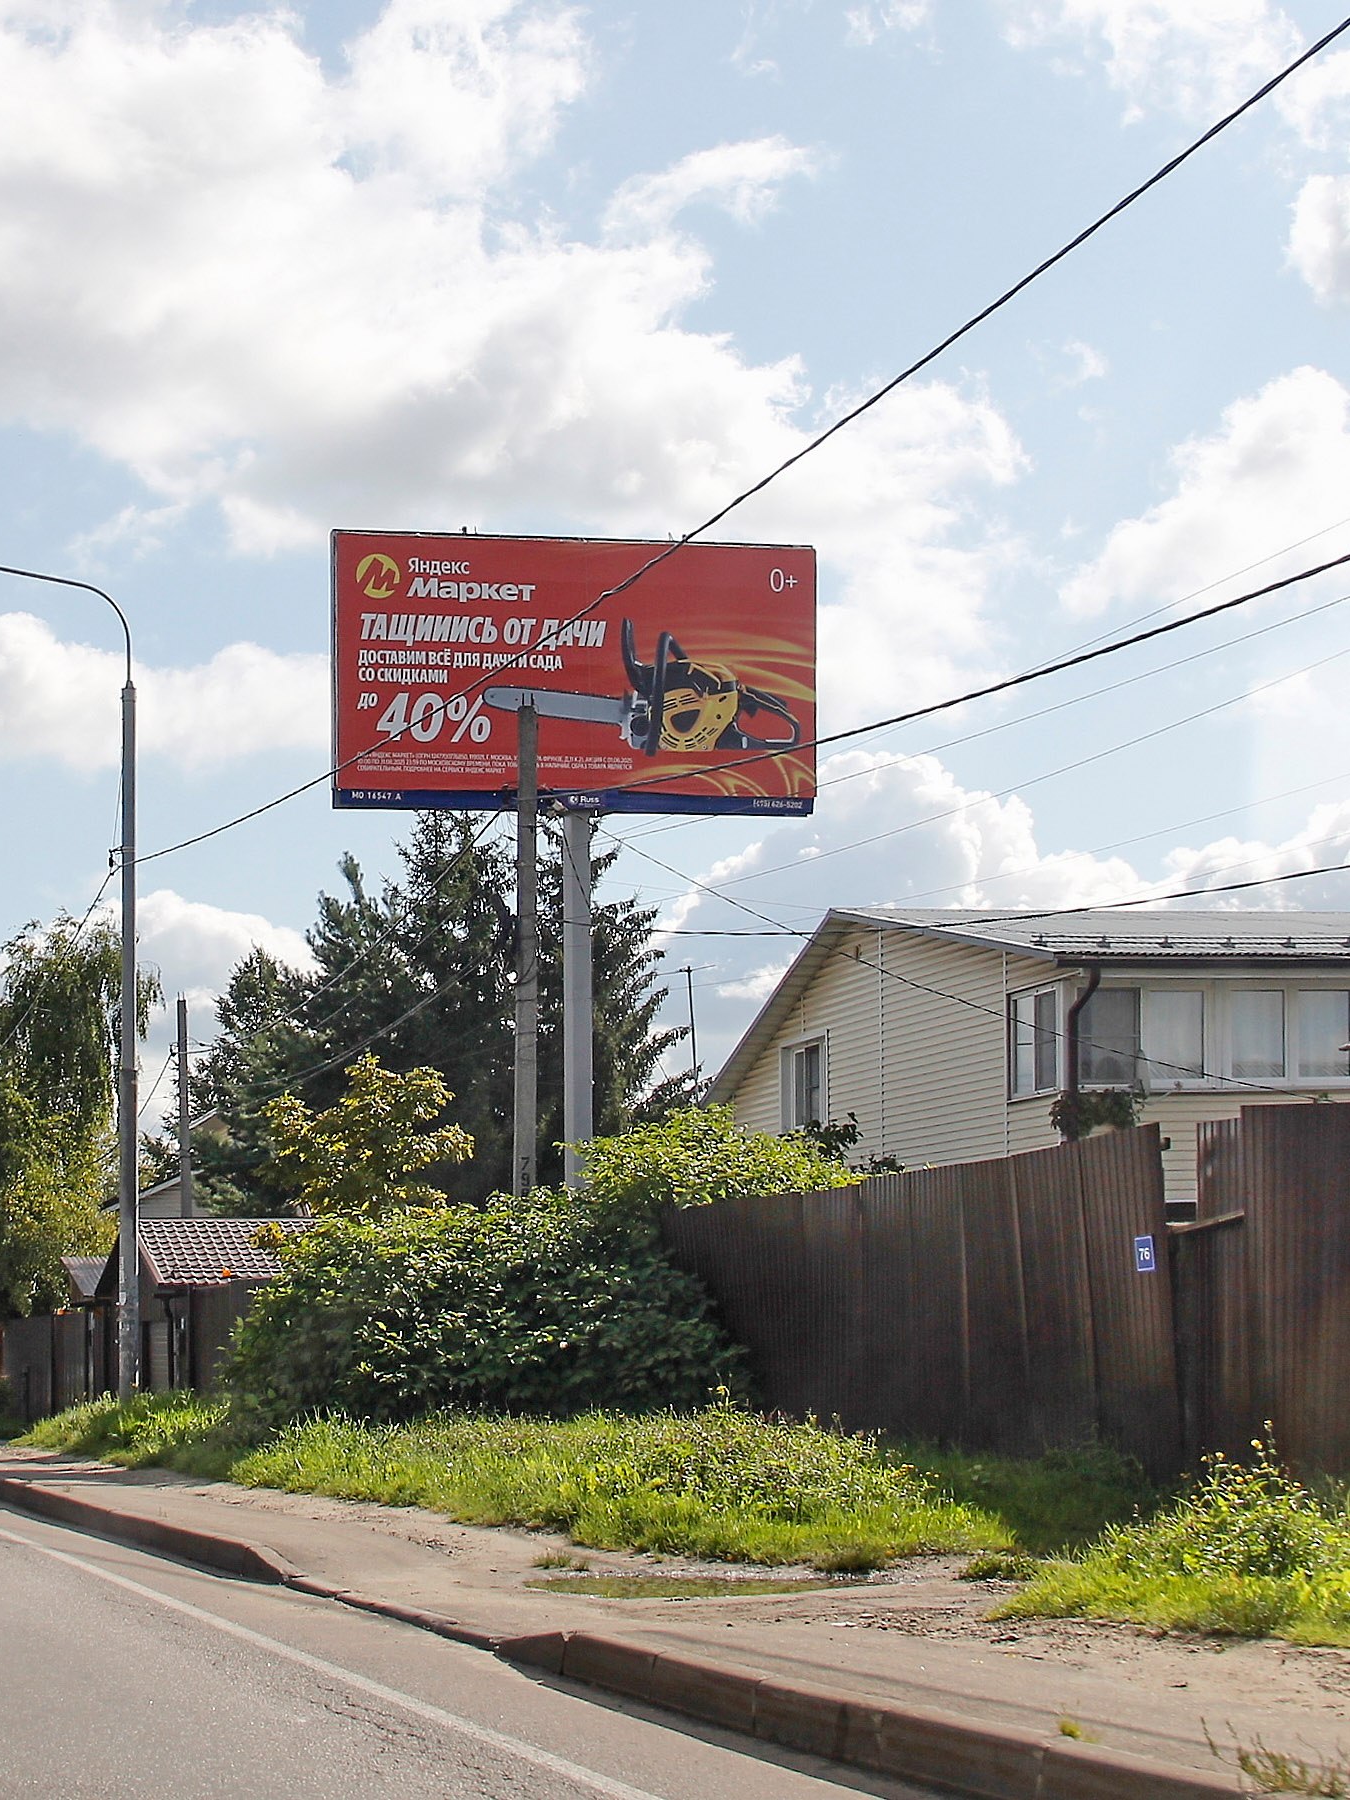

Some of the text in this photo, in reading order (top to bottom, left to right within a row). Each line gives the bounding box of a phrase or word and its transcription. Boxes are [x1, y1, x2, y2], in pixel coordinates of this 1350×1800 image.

[408, 557, 470, 576] Яндекс
[406, 577, 536, 602] Маркет
[770, 568, 798, 592] 0+
[360, 613, 607, 651] ТАЩИИИСЬ ОТ ДАЧИ
[358, 649, 428, 666] ДОСТАВИМ
[428, 649, 451, 666] ВСЁ
[453, 654, 481, 668] ДЛЯ
[482, 654, 517, 669] ДАЧИ
[529, 655, 563, 671] САДА
[358, 668, 448, 685] СО СКИДКАМИ
[376, 692, 491, 743] 40%
[1139, 1247, 1151, 1260] 76
